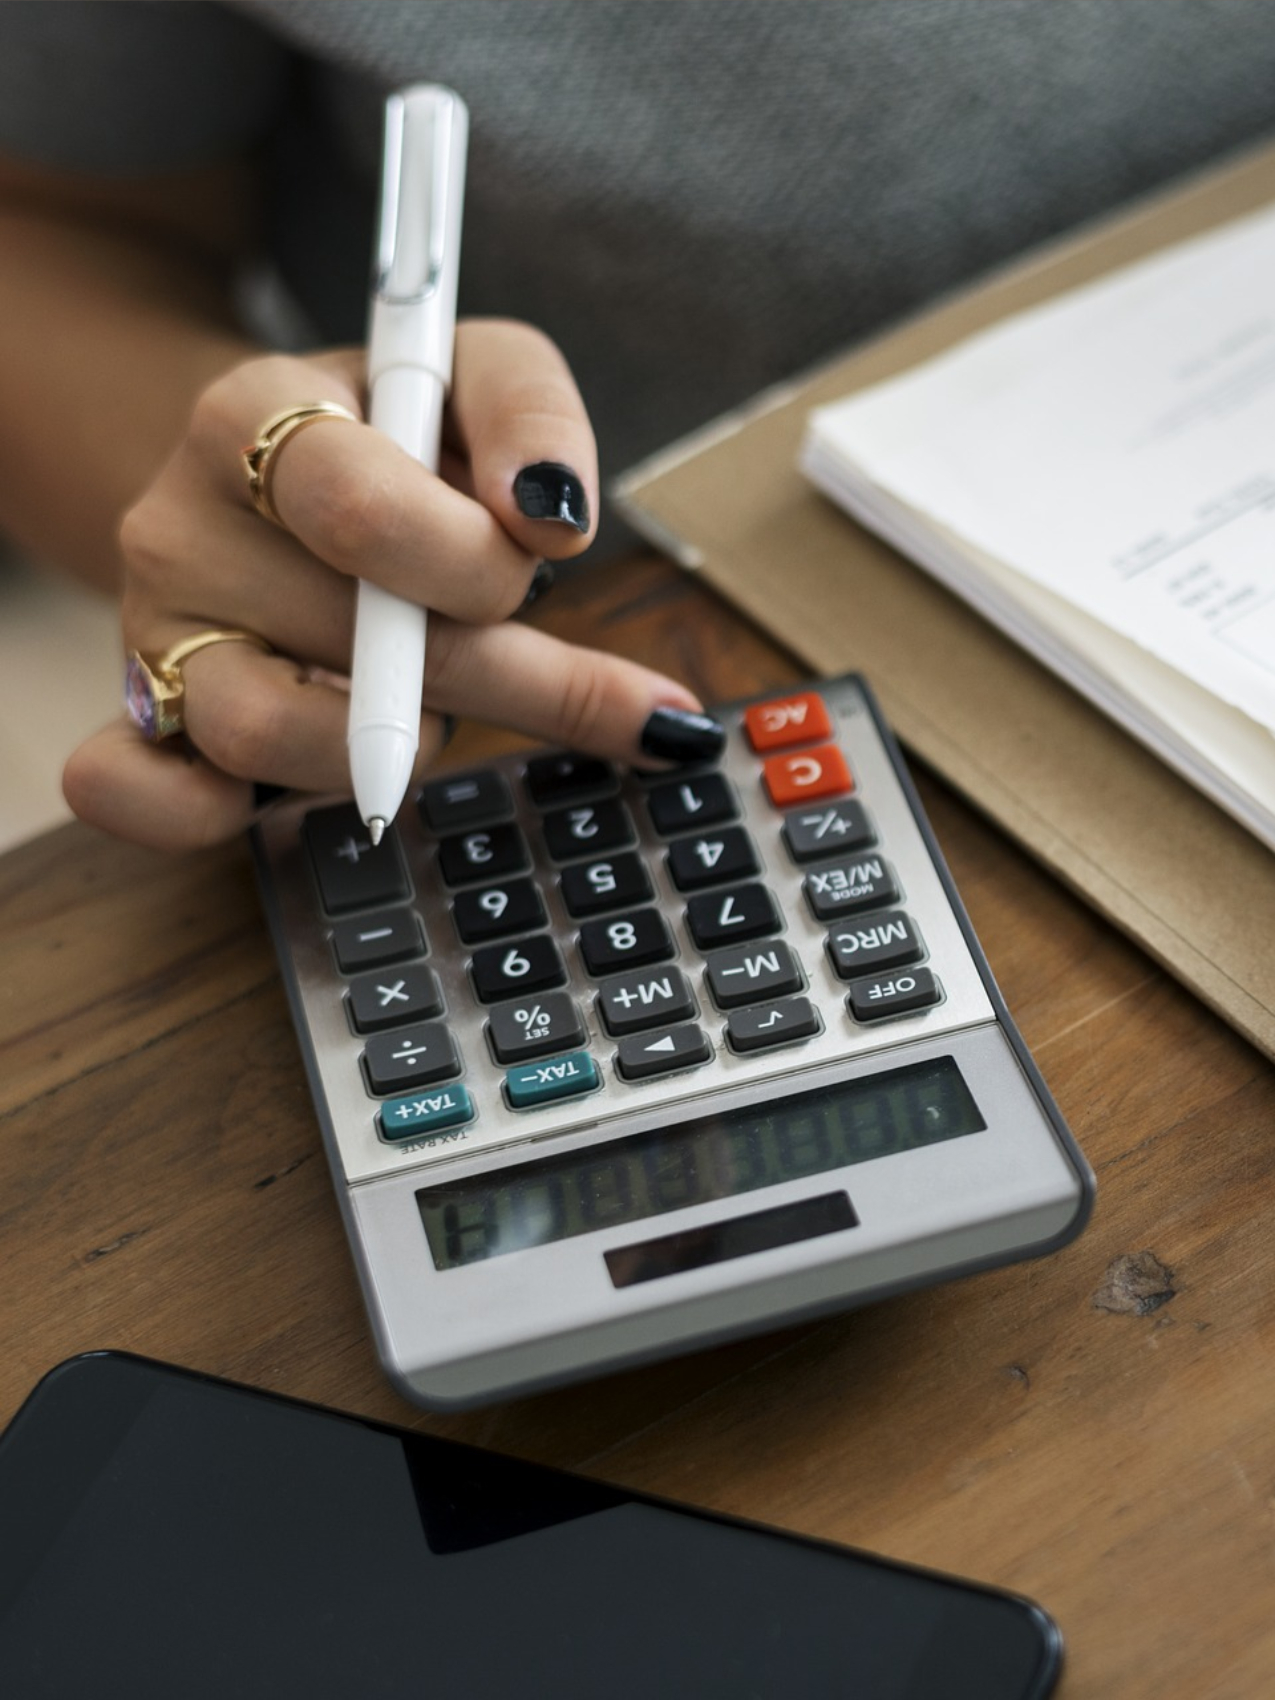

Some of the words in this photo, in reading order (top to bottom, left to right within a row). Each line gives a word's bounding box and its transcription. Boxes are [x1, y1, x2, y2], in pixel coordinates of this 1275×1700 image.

[763, 703, 808, 731] AC
[788, 757, 822, 786] C
[681, 786, 703, 812] 1
[571, 810, 598, 838] 2
[466, 835, 493, 863] 3
[696, 841, 724, 867] 4
[588, 864, 616, 893] 5
[810, 860, 883, 893] M/EX
[831, 880, 874, 901] MODE
[480, 891, 508, 918] 6
[719, 897, 745, 926] 7
[607, 922, 637, 950] 8
[836, 920, 908, 953] MRC
[502, 949, 530, 977] 9
[612, 978, 673, 1008] M+
[868, 977, 916, 999] OFF
[525, 1027, 550, 1040] SET
[395, 1094, 456, 1119] TAX+
[398, 1136, 436, 1154] RATE
[436, 1128, 467, 1144] TAX
